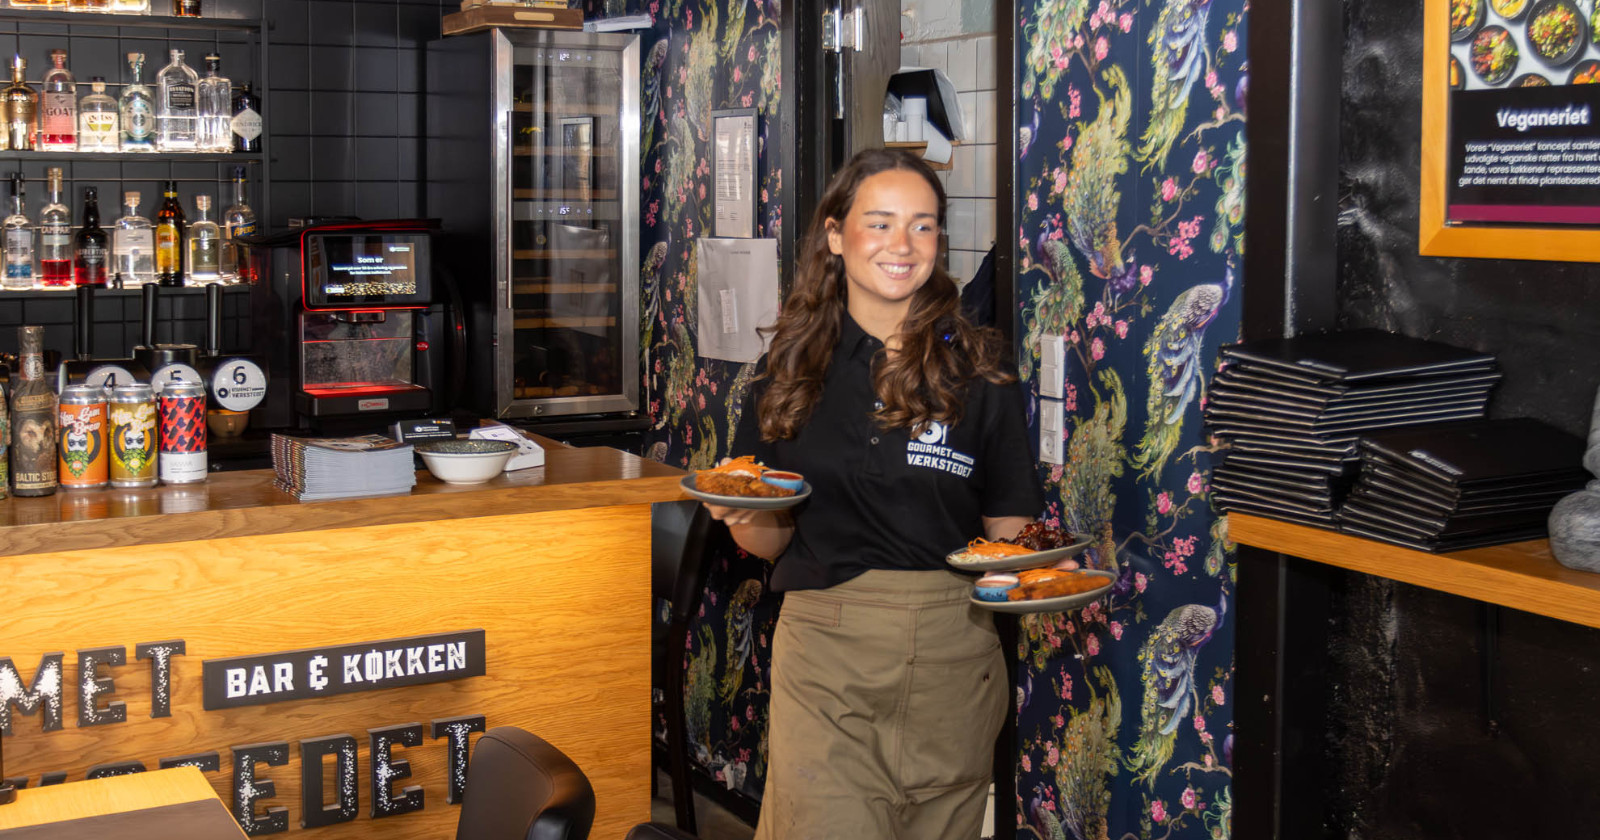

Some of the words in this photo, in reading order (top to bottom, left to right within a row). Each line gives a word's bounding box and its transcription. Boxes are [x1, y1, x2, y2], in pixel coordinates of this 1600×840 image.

[46, 107, 74, 117] GOAT
[1496, 104, 1589, 132] Veganeriet
[1465, 143, 1487, 152] Vores
[1537, 142, 1571, 153] koncept
[1465, 154, 1499, 165] udvalgte
[1500, 154, 1537, 165] veganske
[1538, 154, 1561, 162] retter
[1562, 153, 1575, 161] fra
[1576, 152, 1598, 161] hvert
[1464, 165, 1487, 174] lande,
[1472, 176, 1486, 184] det
[1519, 176, 1538, 184] finde
[357, 256, 374, 264] Som
[103, 372, 117, 391] 4
[233, 366, 246, 385] 6
[907, 441, 953, 458] GOURMET
[906, 453, 973, 478] VÆRKSTEDET
[16, 472, 41, 482] BALTIC
[226, 662, 295, 699] BAR
[309, 655, 329, 690] &
[343, 641, 467, 684] KØKKEN
